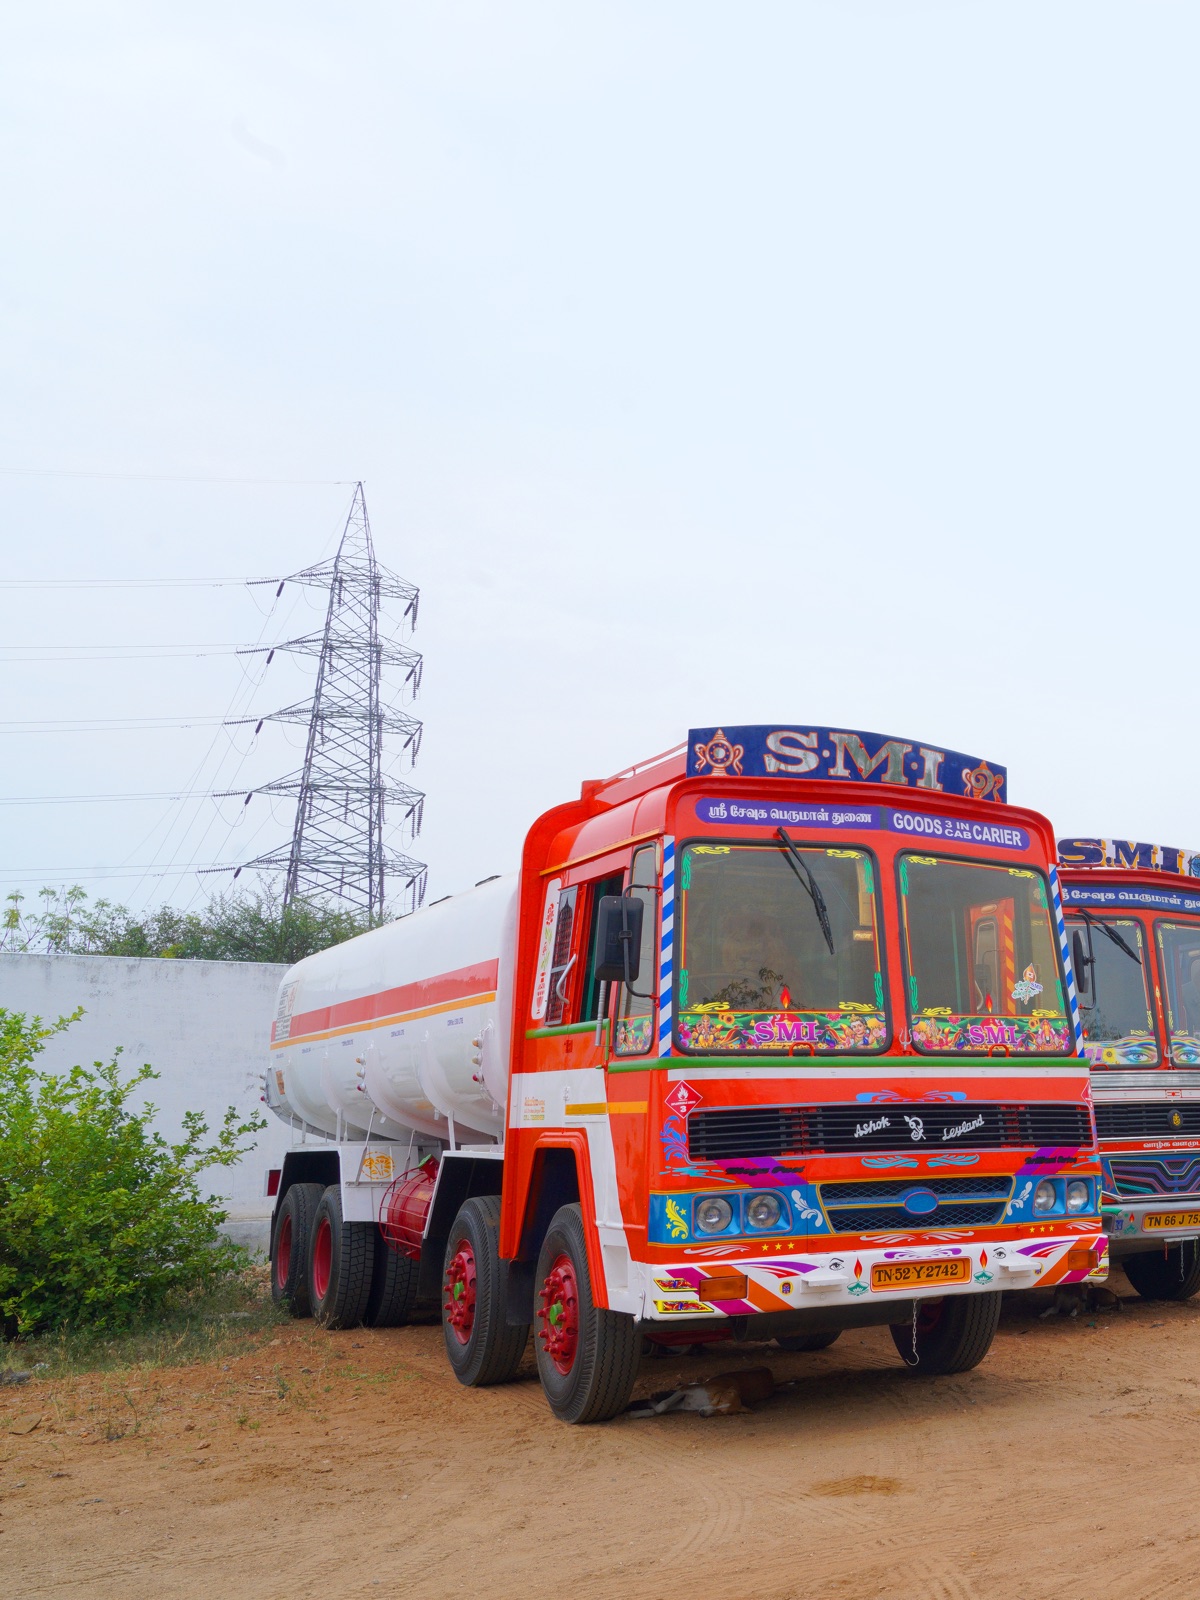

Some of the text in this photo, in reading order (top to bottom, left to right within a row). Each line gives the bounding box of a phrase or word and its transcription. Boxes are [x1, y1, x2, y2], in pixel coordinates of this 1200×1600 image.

[730, 804, 768, 821] சேவுக
[770, 808, 830, 823] பெருமாள்
[832, 812, 872, 825] துணை
[893, 812, 1022, 847] GOODS 3 IN CAB CARIER
[1071, 889, 1116, 902] சேவுக
[1118, 892, 1182, 905] பெருமாள்
[753, 1020, 819, 1044] SMI
[968, 1025, 1018, 1046] SMI
[680, 1105, 687, 1113] 3
[942, 1114, 985, 1141] Leyland
[1147, 1216, 1162, 1227] TN
[1164, 1215, 1176, 1226] 66
[1179, 1215, 1185, 1225] J
